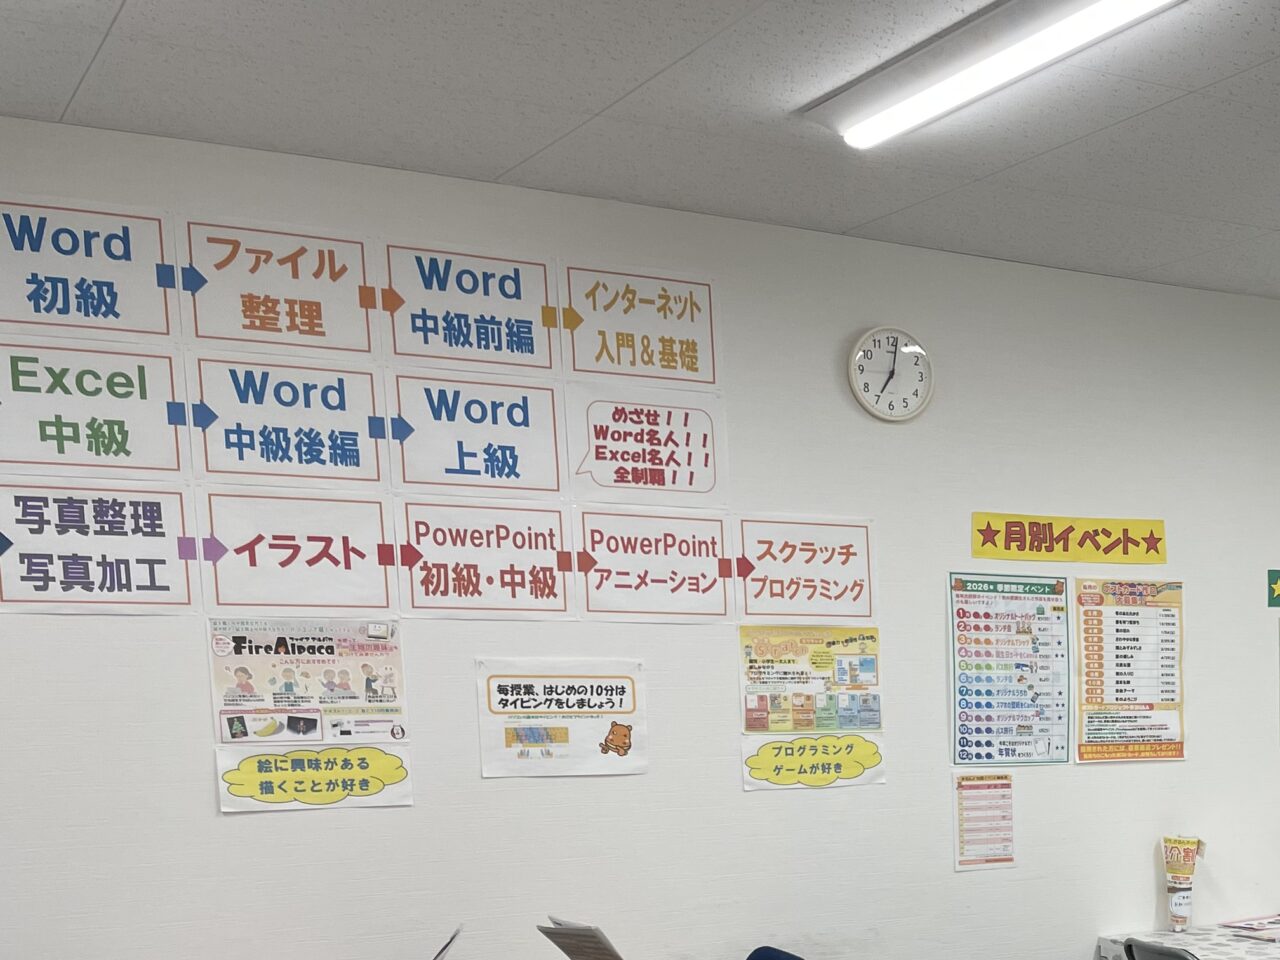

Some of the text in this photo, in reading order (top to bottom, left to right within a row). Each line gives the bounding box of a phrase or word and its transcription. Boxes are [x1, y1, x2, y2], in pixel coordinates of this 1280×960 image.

[2, 213, 132, 262] Word
[207, 236, 348, 282] ファイル
[415, 255, 522, 300] Word
[26, 273, 120, 319] 初級
[585, 280, 702, 323] インターネット
[240, 292, 326, 337] 整理
[410, 308, 535, 355] 中級前編
[872, 339, 881, 349] 11
[595, 330, 700, 373] 入門＆基礎
[862, 349, 873, 360] 10
[913, 355, 920, 366] 2
[10, 355, 147, 400] Excel
[858, 364, 865, 374] 9
[918, 371, 924, 382] 3
[228, 369, 347, 412] Word
[863, 382, 870, 392] 8
[874, 394, 881, 405] 7
[912, 388, 919, 398] 4
[423, 387, 530, 428] Word
[611, 406, 690, 426] めざせ！！
[888, 400, 895, 411] 6
[902, 398, 909, 408] 5
[38, 414, 132, 457] 中級
[224, 422, 361, 467] 中級後編
[444, 440, 521, 479] 上級
[613, 466, 695, 486] 全制覇！！
[14, 495, 165, 538] 写真整理
[414, 520, 557, 551] PowerPoint
[590, 529, 718, 558] PowerPoint
[1004, 521, 1142, 556] 月別イベント
[234, 533, 367, 570] イラスト
[756, 539, 857, 566] スクラッチ
[19, 552, 170, 593] 写真加工
[419, 560, 558, 599] 初級・中級
[593, 567, 718, 595] アニメーション
[750, 575, 865, 602] プログラミング
[232, 636, 335, 655] FireAlpaca
[496, 683, 626, 697] 毎授業、はじめの10分は
[498, 698, 623, 709] タイピングをしましょう！
[772, 743, 854, 758] プログラミング
[257, 757, 370, 773] 絵に興味がある
[773, 762, 843, 776] ゲームが好き
[259, 778, 371, 795] 描くことが好き
